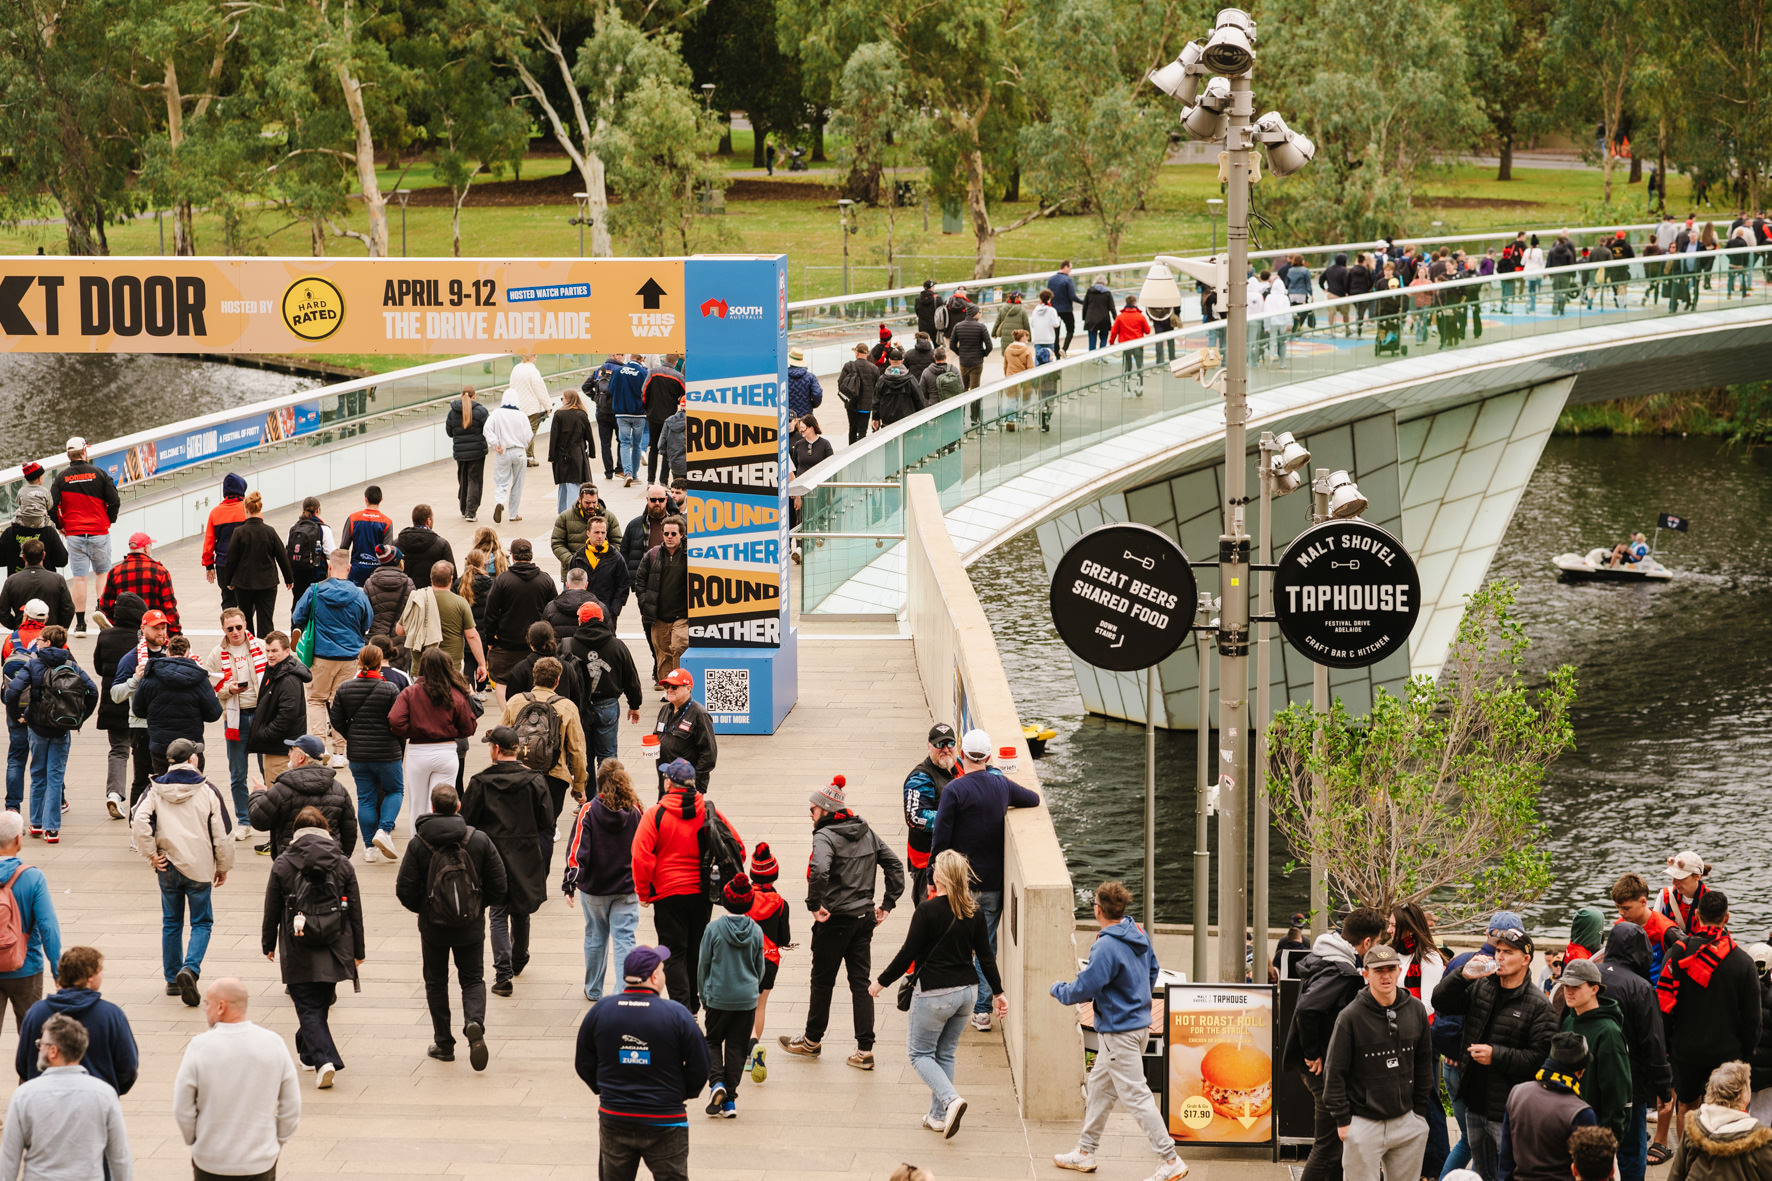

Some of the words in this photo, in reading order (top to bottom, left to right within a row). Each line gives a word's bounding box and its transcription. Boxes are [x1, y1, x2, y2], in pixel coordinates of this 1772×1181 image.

[383, 279, 443, 306] APRIL
[449, 279, 496, 307] 9-12
[510, 290, 535, 300] HOSTED
[536, 287, 559, 298] WATCH
[560, 285, 588, 297] PARTIES
[79, 275, 207, 337] DOOR
[221, 301, 257, 313] HOSTED
[260, 301, 273, 313] BY
[298, 301, 327, 312] HARD
[729, 306, 763, 315] SOUTH
[292, 309, 338, 326] RATED
[383, 311, 421, 339] THE
[426, 311, 488, 339] DRIVE
[493, 311, 591, 339] ADELAIDE
[628, 313, 675, 325] THIS
[631, 326, 673, 337] WAY
[620, 367, 640, 376] Ford
[686, 382, 778, 408] GATHER
[686, 415, 778, 453] ROUND
[160, 447, 179, 460] WELCOME
[186, 433, 202, 459] GATHER
[65, 473, 96, 482] BOMBERS
[687, 461, 779, 488] GATHER
[687, 496, 779, 534] ROUND
[688, 539, 779, 564] GATHER
[1296, 536, 1335, 568] MALT
[1341, 534, 1396, 568] SHOVEL
[688, 572, 780, 609] ROUND
[1080, 559, 1129, 589] GREAT
[1129, 579, 1178, 610] BEERS
[1072, 579, 1130, 614] SHARED
[1130, 603, 1169, 630] FOOD
[1285, 584, 1409, 613] TAPHOUSE
[689, 617, 781, 644] GATHER
[1094, 626, 1117, 640] STAIRS
[1099, 620, 1118, 632] DOWN
[1305, 635, 1330, 654] CRAFT
[1330, 649, 1347, 658] BAR
[1349, 650, 1355, 658] &
[1357, 634, 1391, 657] KITCHEN
[711, 715, 719, 724] ND
[719, 715, 732, 724] OUT
[732, 715, 750, 724] MORE
[1213, 995, 1248, 1003] TAPHOUSE
[1175, 1015, 1196, 1026] HOT
[1199, 1015, 1234, 1026] ROAST
[1237, 1015, 1265, 1027] ROLL
[1190, 1026, 1204, 1034] FOR
[1206, 1026, 1220, 1034] THE
[1183, 1109, 1211, 1119] $17.90
